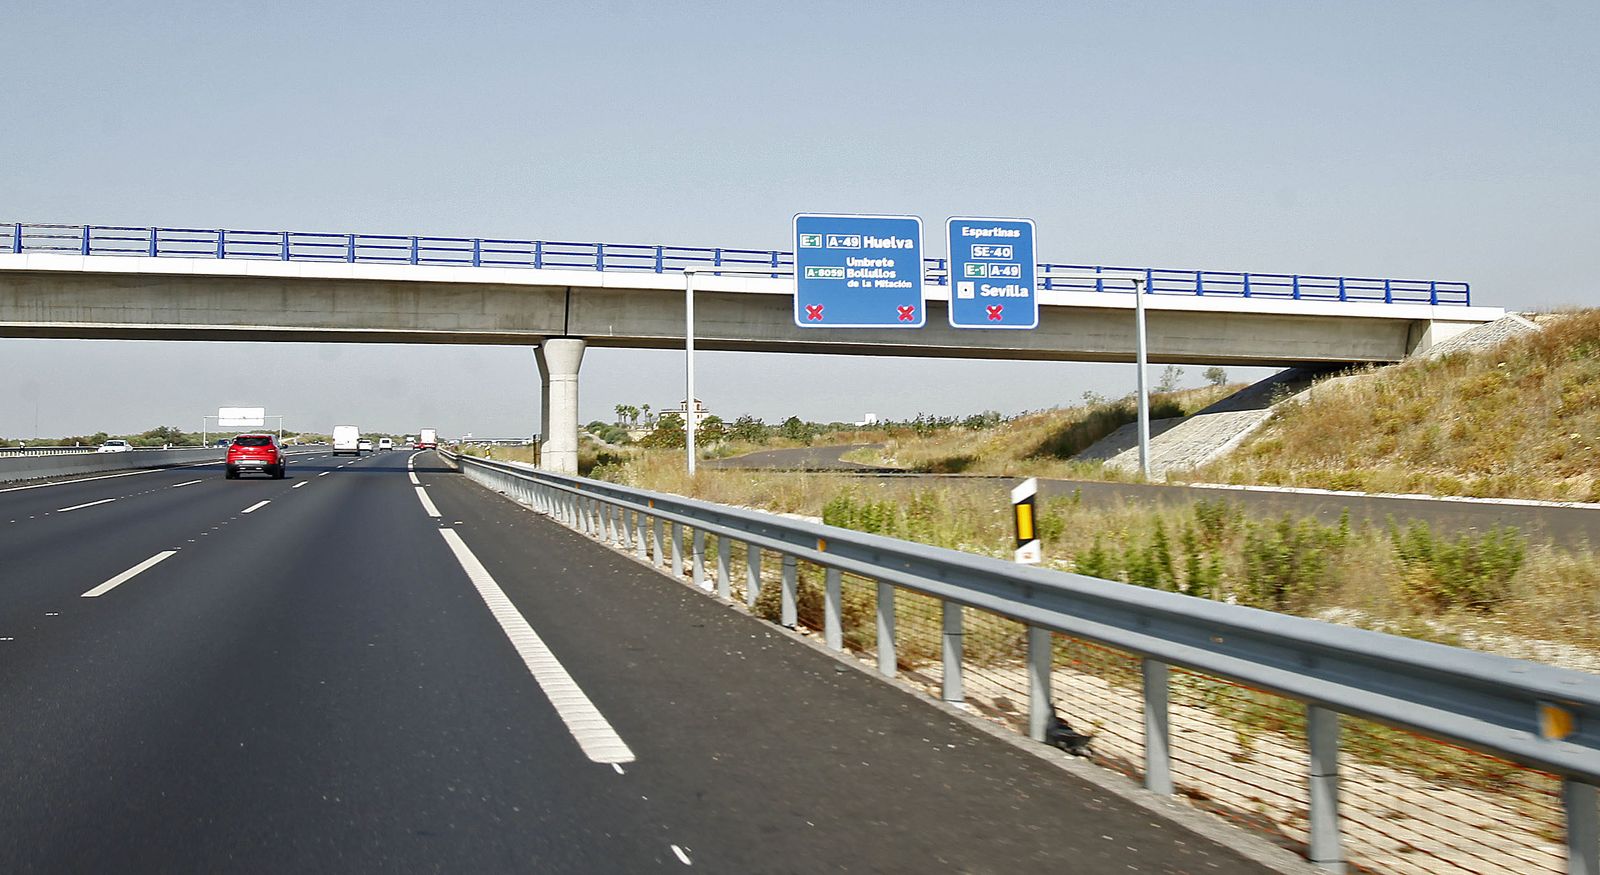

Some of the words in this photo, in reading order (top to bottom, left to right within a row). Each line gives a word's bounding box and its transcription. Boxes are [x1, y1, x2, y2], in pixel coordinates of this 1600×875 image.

[962, 226, 1020, 238] Espartinas
[802, 236, 820, 246] E-1
[829, 236, 859, 246] A-49
[863, 236, 914, 249] Huelva
[974, 246, 1010, 257] SE-40
[846, 256, 894, 267] Umbrete
[807, 268, 843, 277] A-8059
[846, 268, 896, 278] Bollullos
[967, 265, 984, 275] E-1
[991, 265, 1020, 275] A-49
[847, 279, 859, 287] de
[862, 279, 872, 287] la
[875, 279, 912, 288] Mitación
[980, 284, 1029, 298] Sevilla
